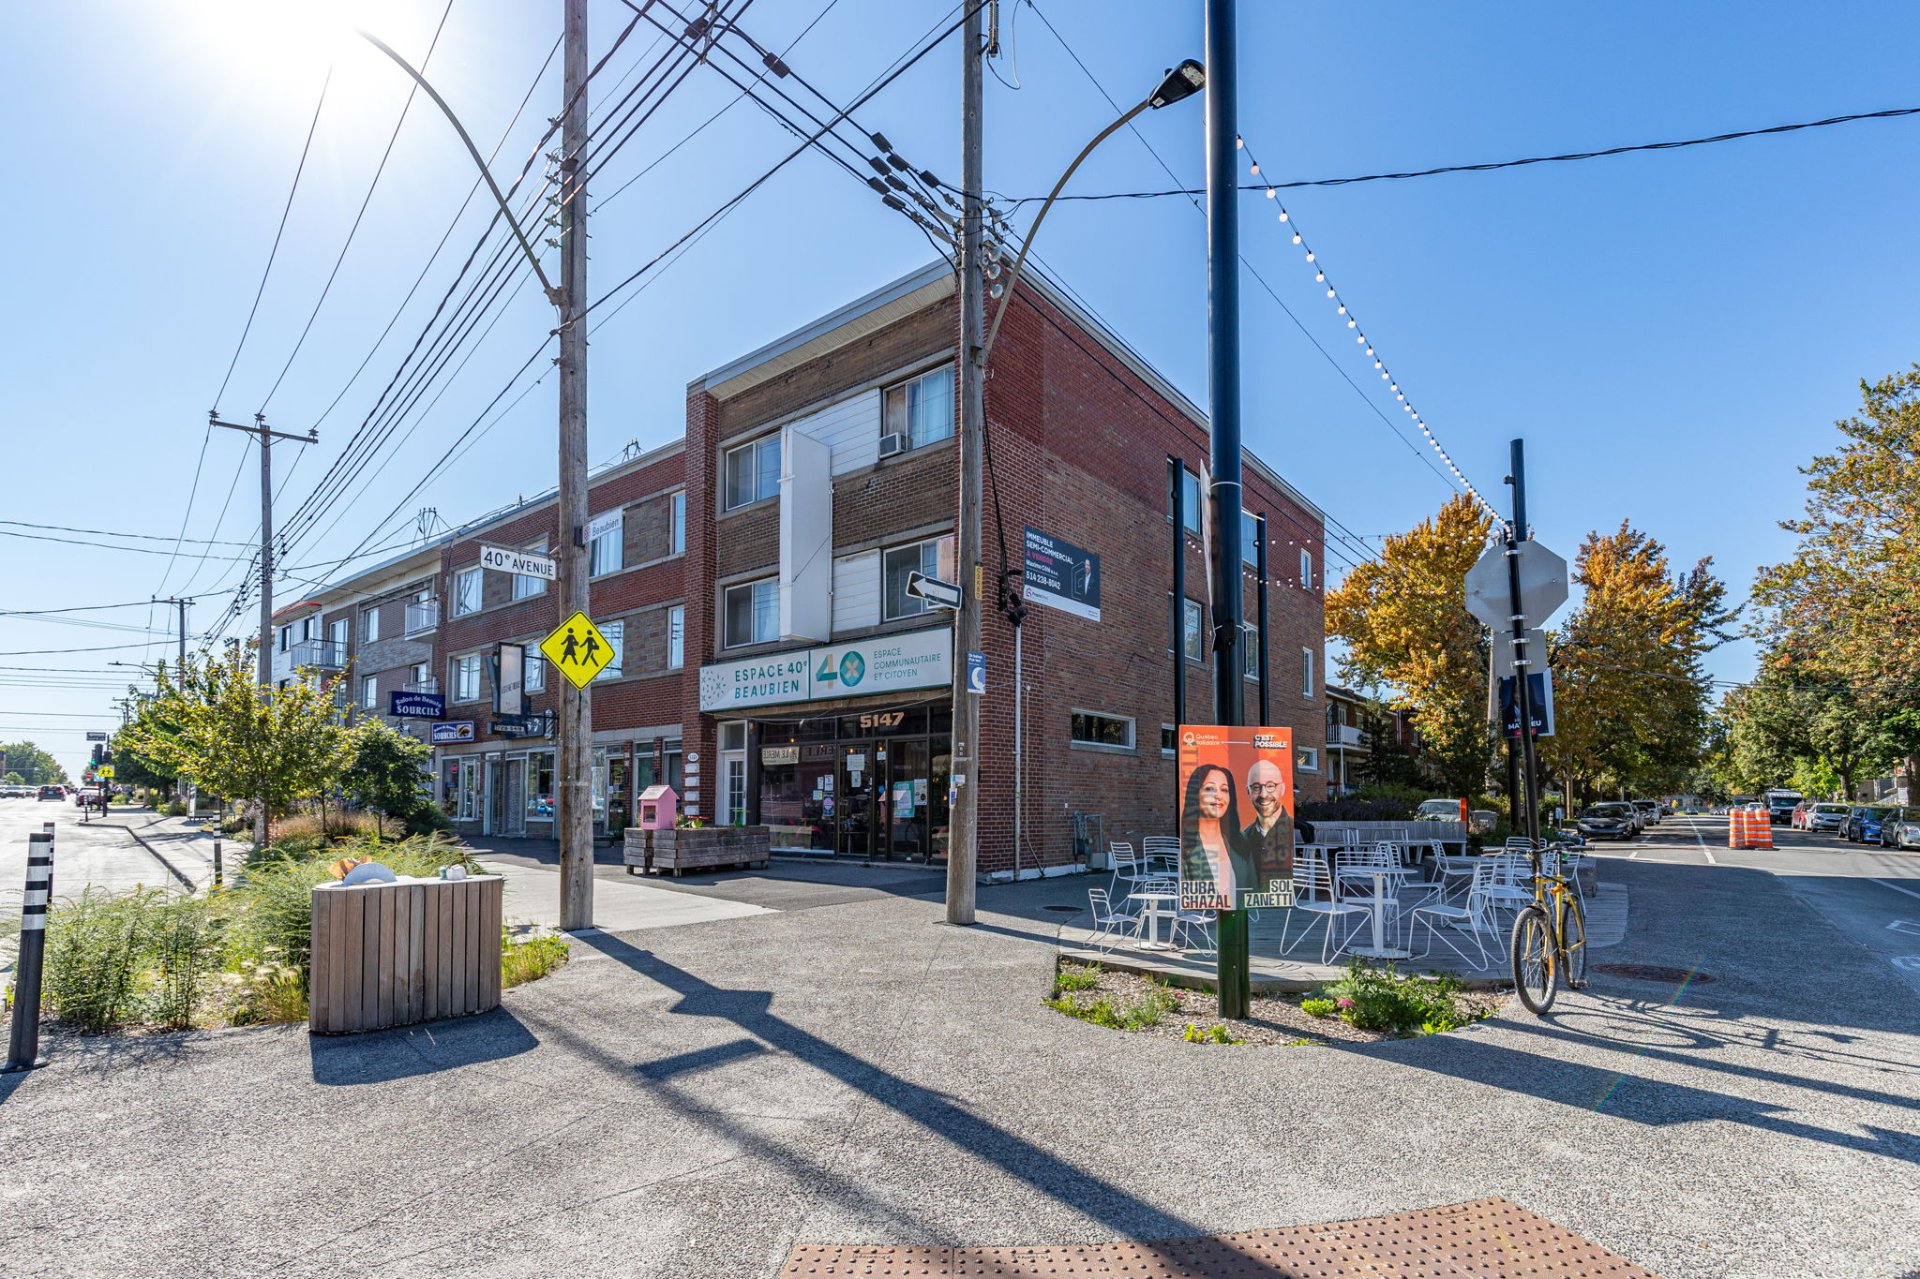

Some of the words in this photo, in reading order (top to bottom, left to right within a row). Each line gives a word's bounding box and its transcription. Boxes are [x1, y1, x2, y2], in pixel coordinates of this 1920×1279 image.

[592, 518, 619, 537] Beaubien
[1026, 541, 1073, 564] SEMI-COMMERCIAL
[512, 558, 554, 577] AVENUE
[874, 647, 901, 659] ESPACE
[874, 653, 942, 670] COMMUNAUTAIRE
[735, 664, 783, 682] ESPACE
[874, 672, 882, 681] ET
[885, 668, 917, 680] CITOYEN
[734, 680, 799, 699] BEAUBIEN
[396, 705, 440, 716] SOURCILS
[860, 711, 905, 728] 5147
[1254, 741, 1288, 749] POSSIBLE
[1181, 881, 1216, 895] RUBA
[1271, 880, 1293, 893] SOL
[1181, 894, 1232, 909] GHAZAL
[1246, 892, 1293, 907] ZANETTI
